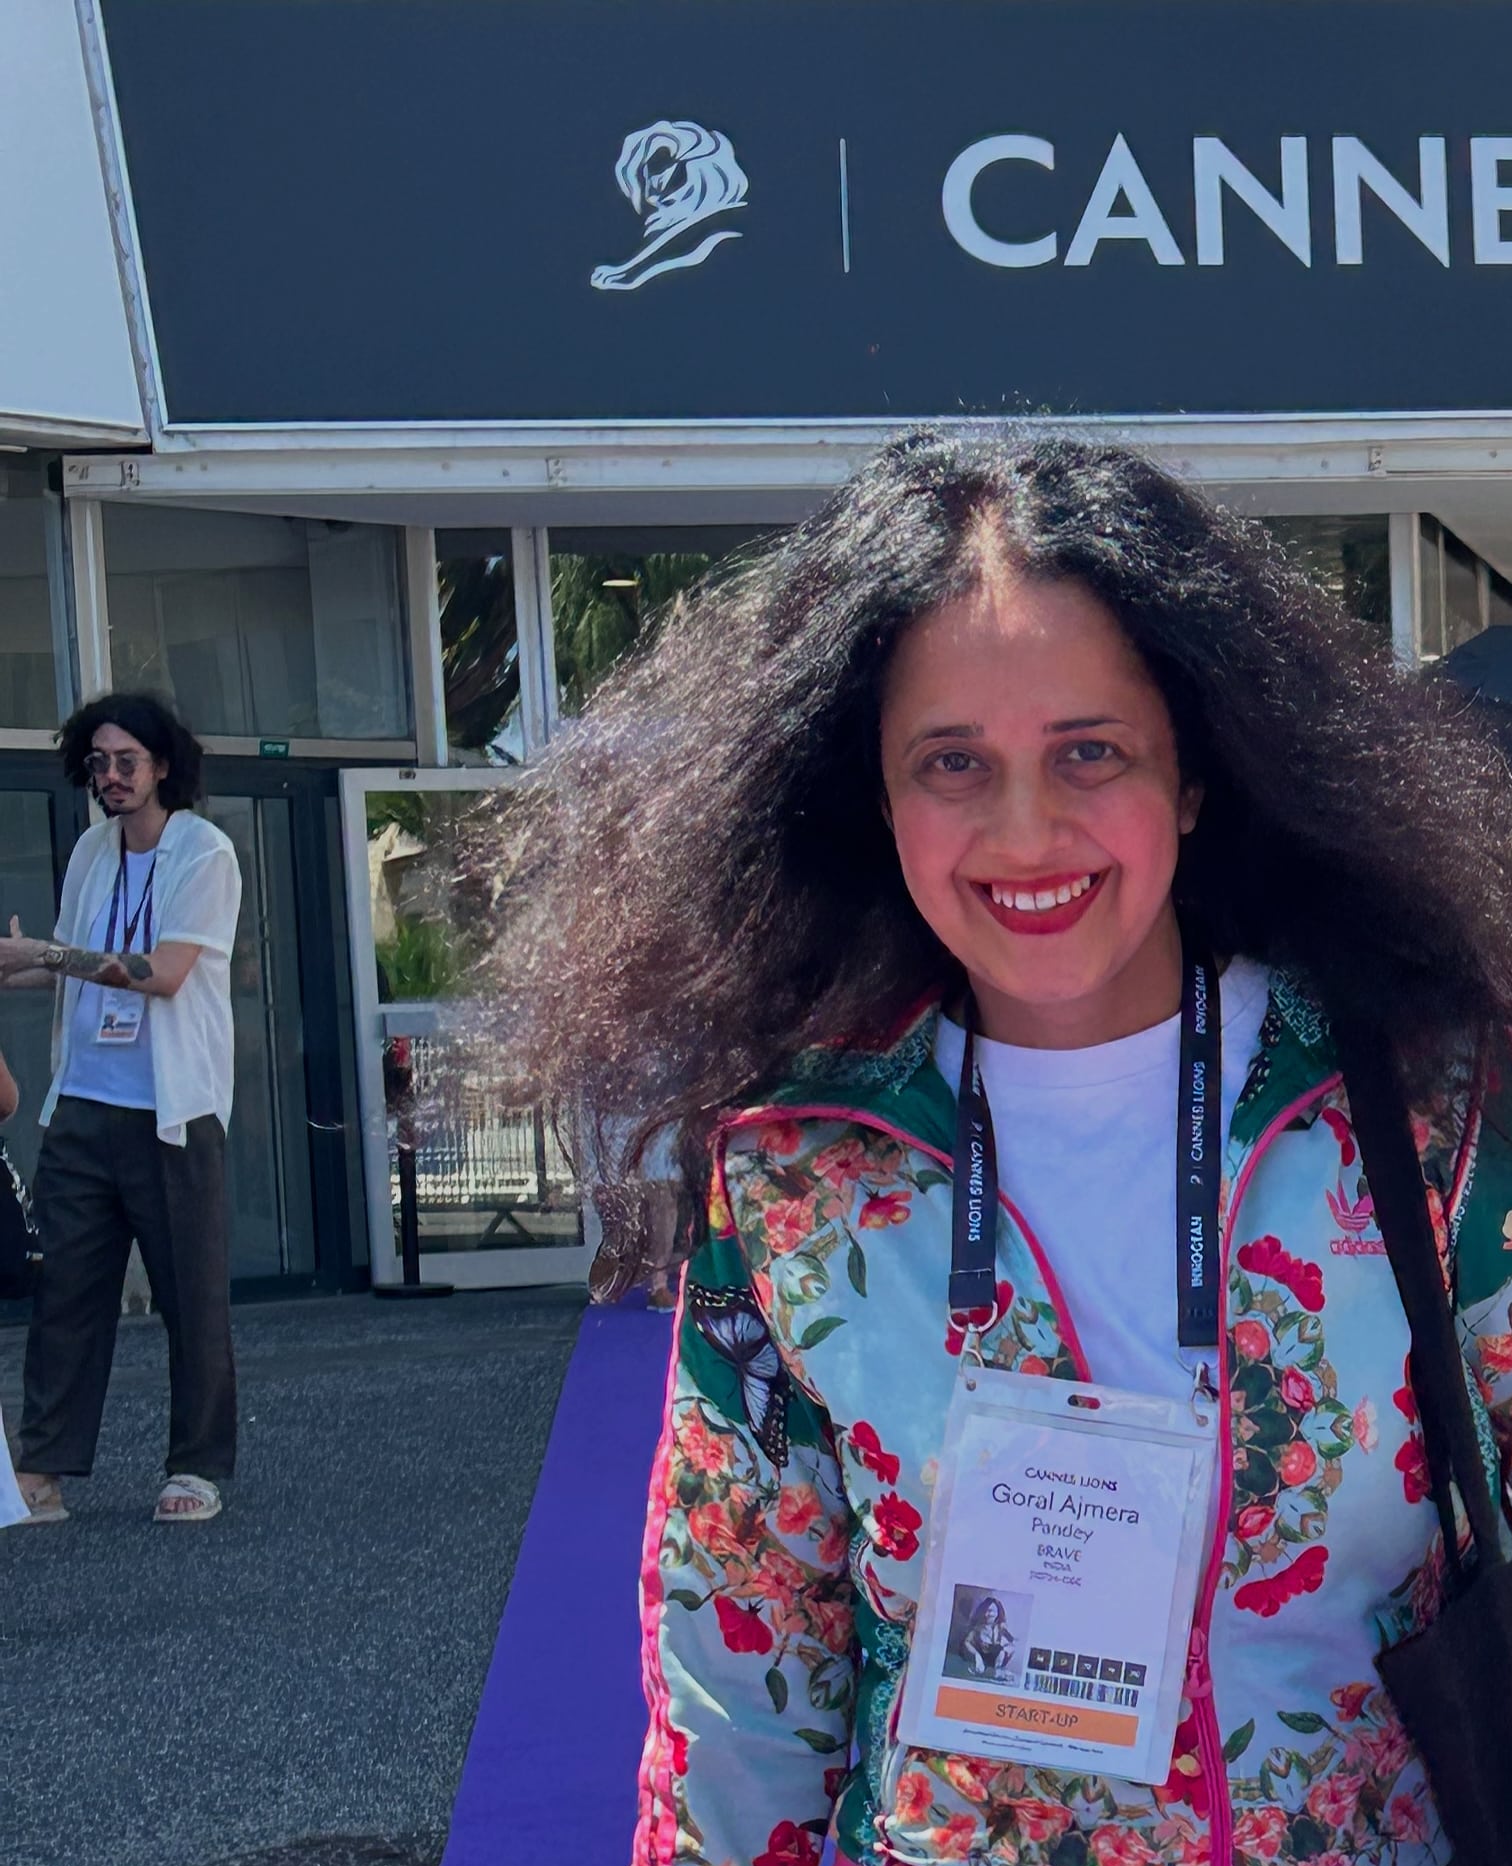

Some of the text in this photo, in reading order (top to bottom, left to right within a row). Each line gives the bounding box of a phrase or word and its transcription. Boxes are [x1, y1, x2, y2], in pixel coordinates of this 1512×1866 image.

[1191, 1061, 1206, 1103] LIONS
[967, 1198, 983, 1242] LIONS
[992, 1483, 1140, 1524] Goral Ajmera
[1031, 1516, 1095, 1544] Pandey
[995, 1703, 1079, 1728] START-UP
